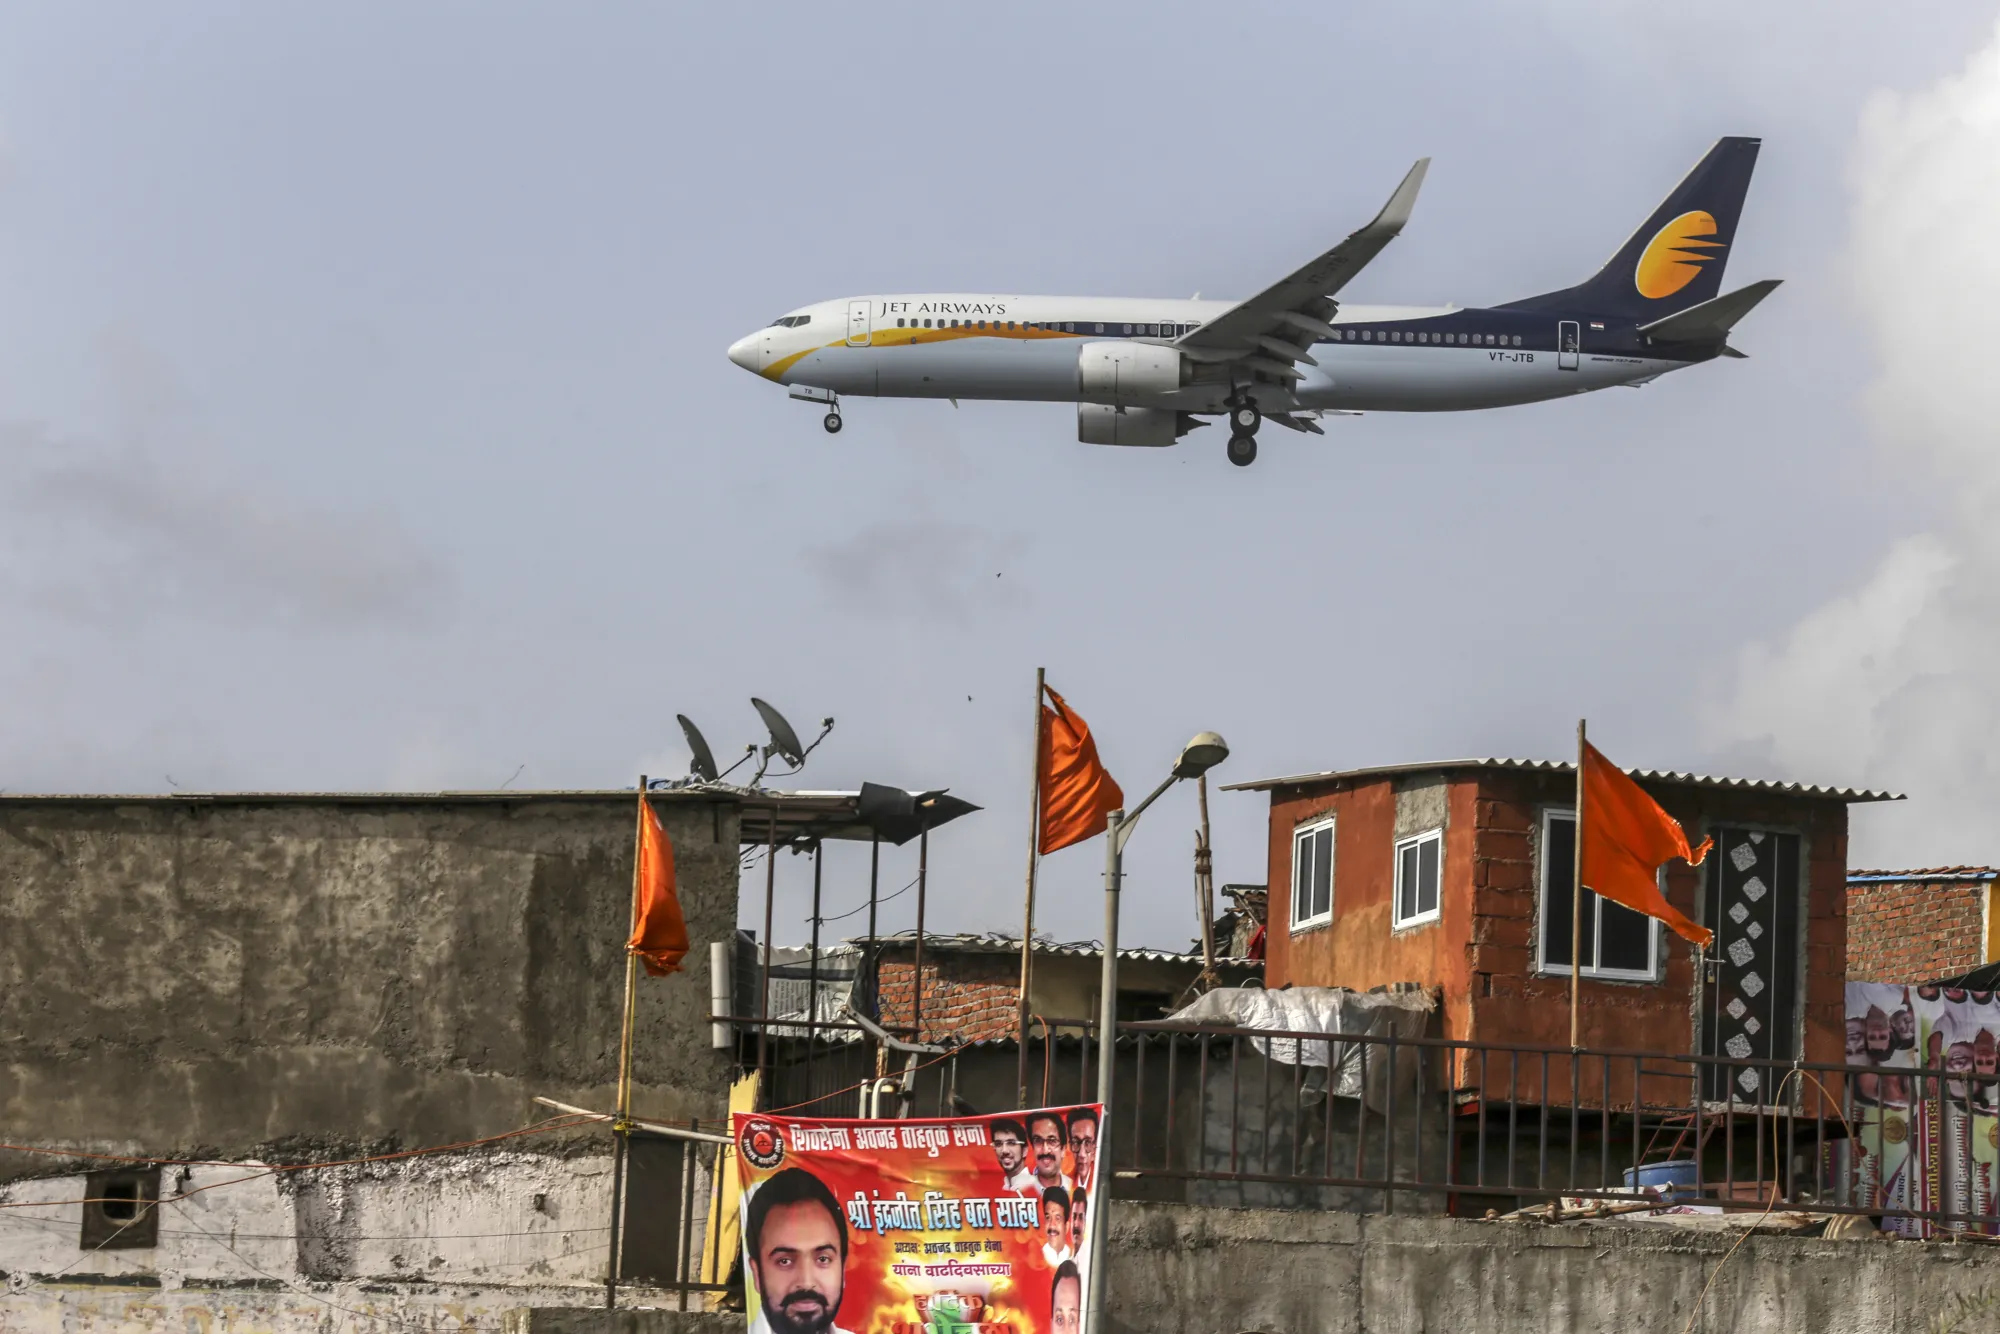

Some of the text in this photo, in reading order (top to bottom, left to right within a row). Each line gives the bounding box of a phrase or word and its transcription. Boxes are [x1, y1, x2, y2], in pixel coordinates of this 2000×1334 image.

[880, 302, 1006, 318] JET AIRWAYS
[1489, 351, 1534, 363] VT-JTB
[788, 1123, 851, 1152] शिवसेना
[853, 1126, 898, 1150] अवजड
[953, 1123, 987, 1148] सेना
[846, 1189, 1040, 1235] श्री इंद्रजीत सिंह बल साहेब
[984, 1238, 1002, 1253] सेना
[892, 1259, 1012, 1278] यांना वाढदिवसाच्या
